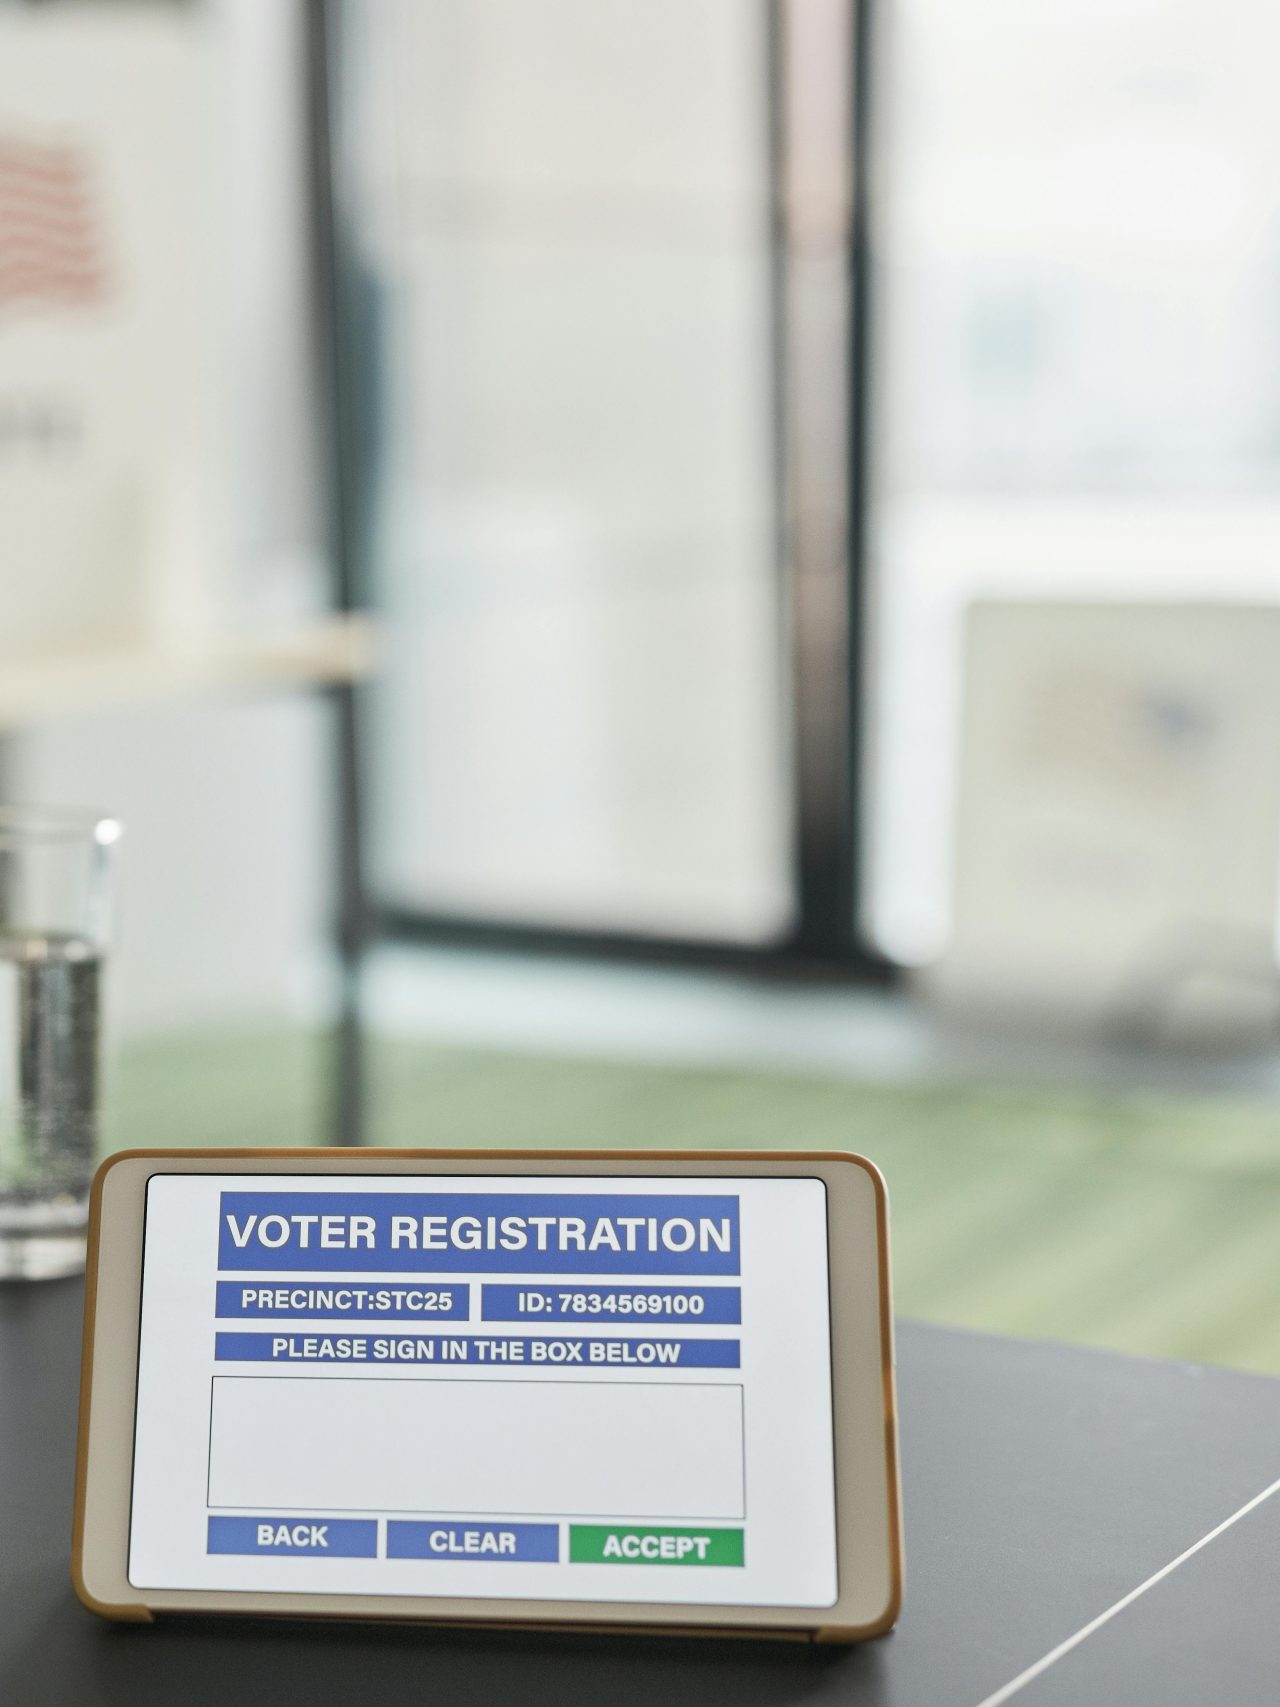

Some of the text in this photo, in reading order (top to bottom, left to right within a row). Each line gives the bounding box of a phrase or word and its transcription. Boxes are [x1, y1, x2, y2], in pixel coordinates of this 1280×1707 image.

[226, 1214, 731, 1253] VOTER REGISTRATION
[241, 1289, 453, 1311] PRECINCT:STC25
[518, 1292, 705, 1315] ID: 7834569100
[272, 1338, 681, 1363] PLEASE SIGN IN THE BOX BELOW
[257, 1524, 329, 1547] BACK
[429, 1530, 516, 1554] CLEAR
[602, 1535, 711, 1559] ACCEPT
